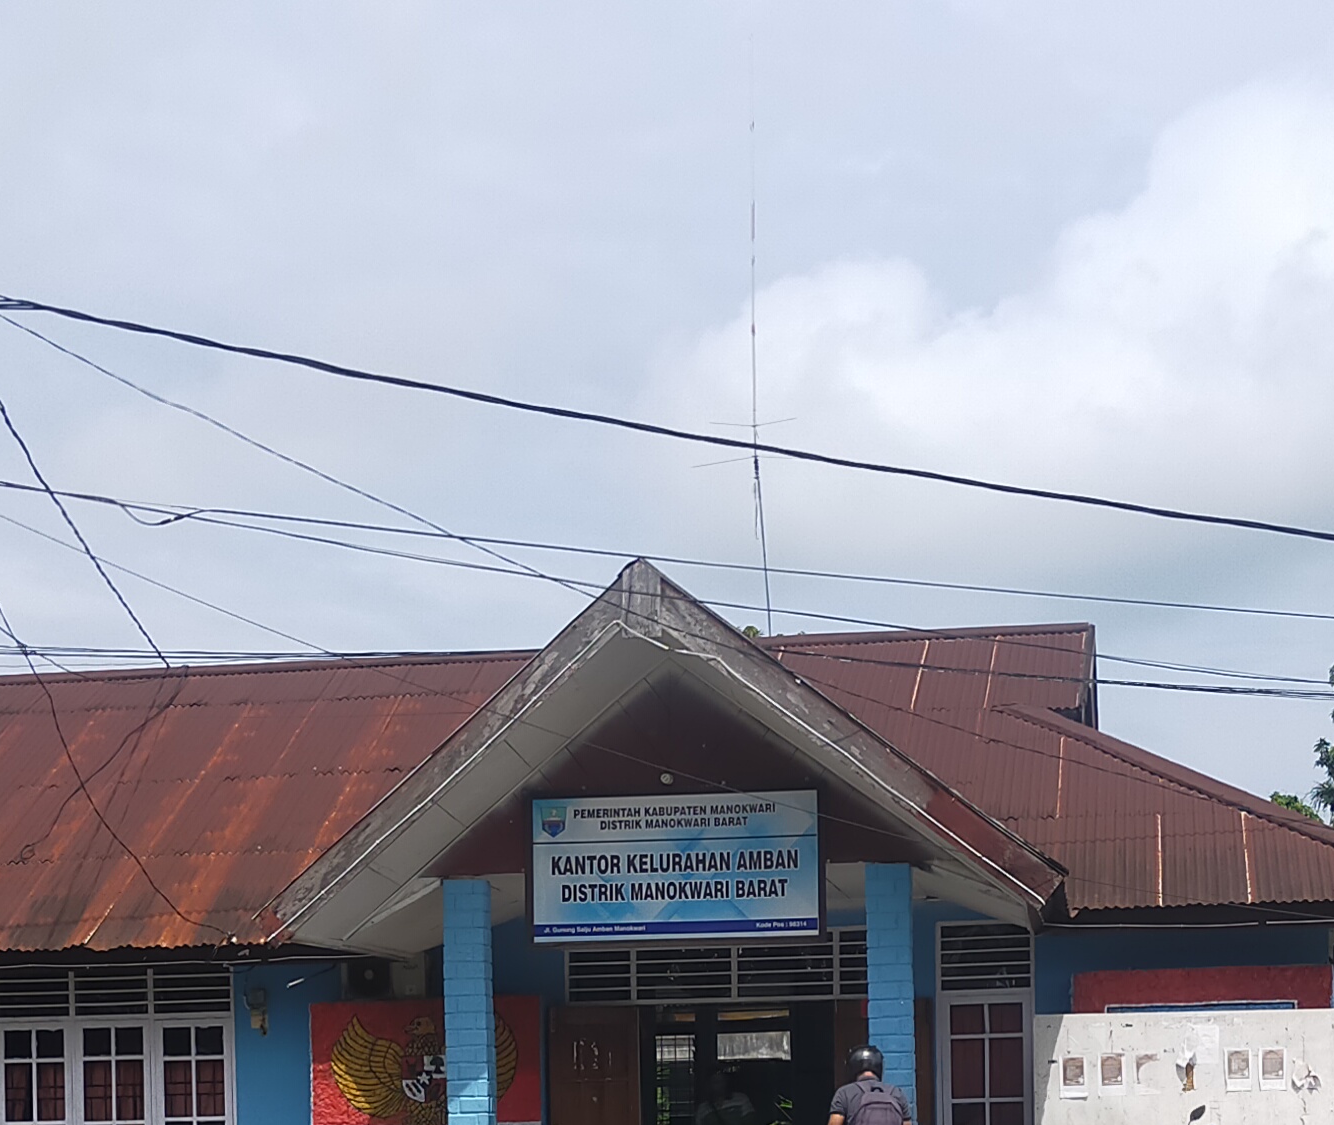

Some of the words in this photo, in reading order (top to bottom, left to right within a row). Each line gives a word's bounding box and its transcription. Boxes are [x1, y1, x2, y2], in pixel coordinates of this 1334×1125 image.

[573, 807, 641, 819] PEMERINTAH
[644, 805, 707, 817] KABUPATEN
[710, 803, 776, 815] MANOKWARI
[599, 819, 643, 831] DISTRIK
[645, 817, 710, 830] MANOKWARI
[713, 816, 748, 827] BARAT
[550, 854, 621, 876] KANTOR
[626, 851, 731, 874] KELURAHAN
[736, 849, 799, 871] AMBAN
[561, 883, 625, 903] DISTRIK
[630, 880, 730, 902] MANOKWARI
[735, 878, 788, 898] BARAT
